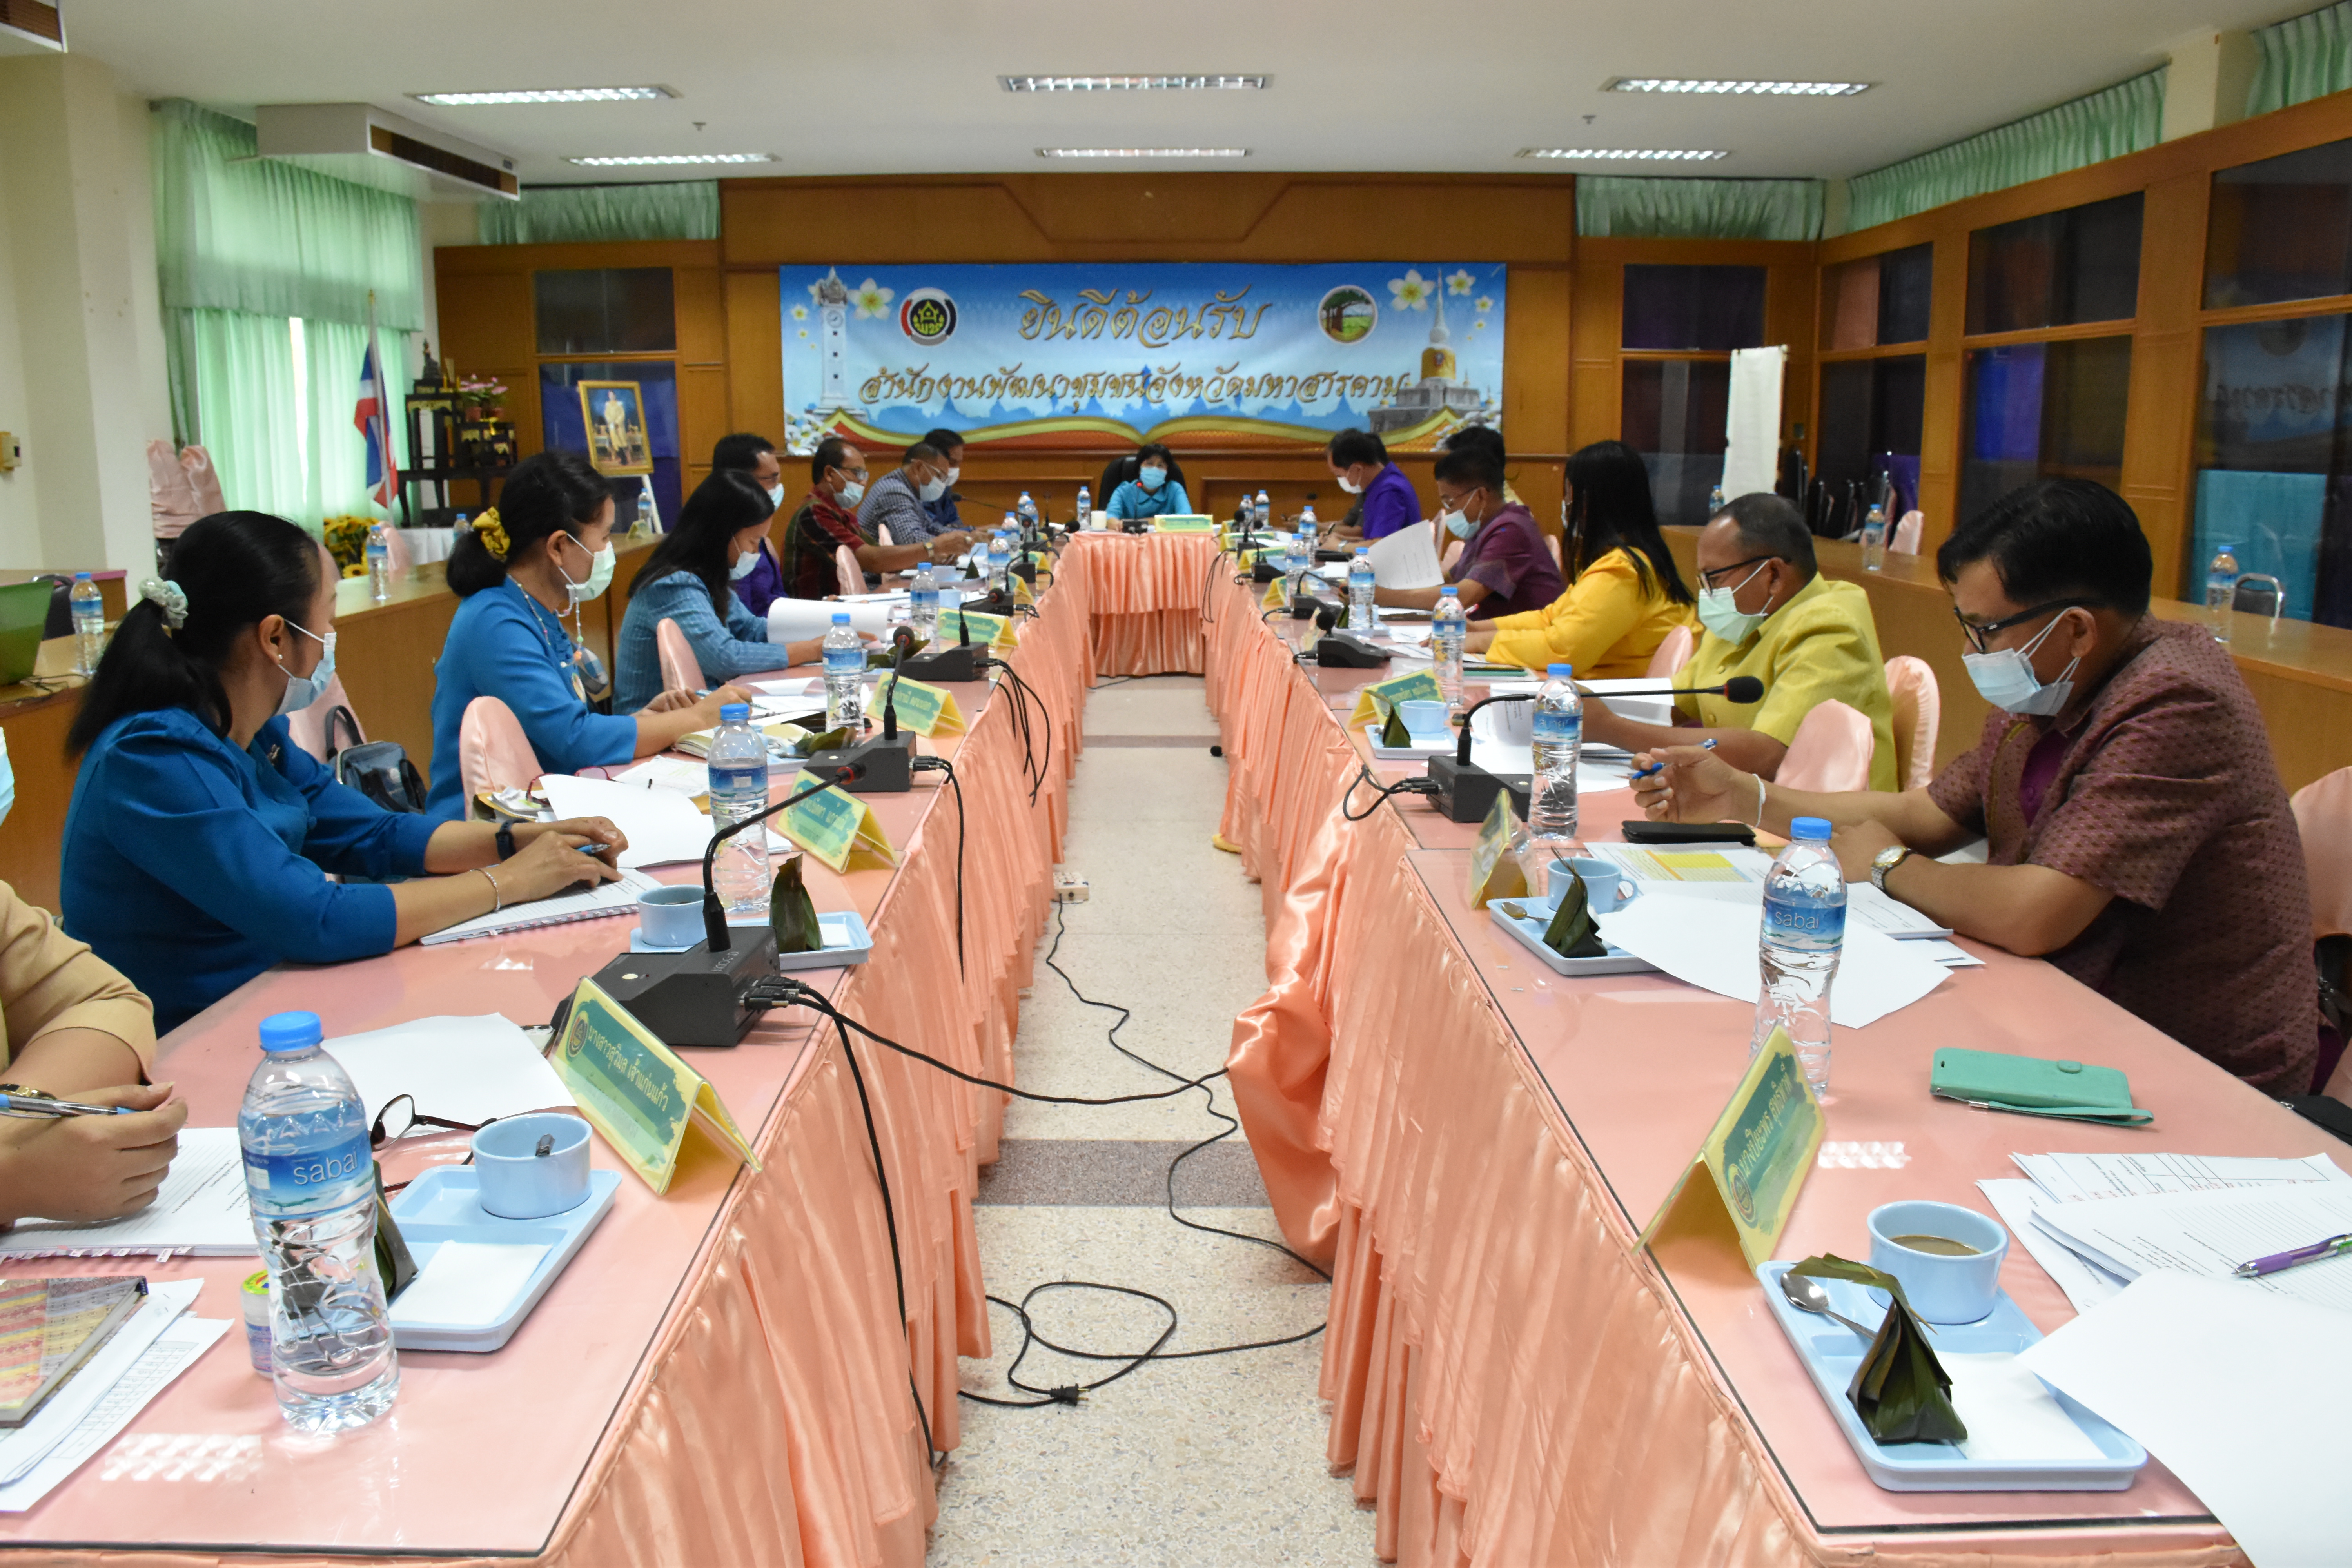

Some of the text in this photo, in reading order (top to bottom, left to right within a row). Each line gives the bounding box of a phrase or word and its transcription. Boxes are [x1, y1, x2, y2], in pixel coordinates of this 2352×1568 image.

[1018, 284, 1273, 348] ยินดีต้อนรับ
[858, 361, 1410, 414] สำนักงานพัฒนาชุมชนจังหวัดมหาสารคาม
[1775, 911, 1820, 929] sabai
[293, 1146, 358, 1185] sabai
